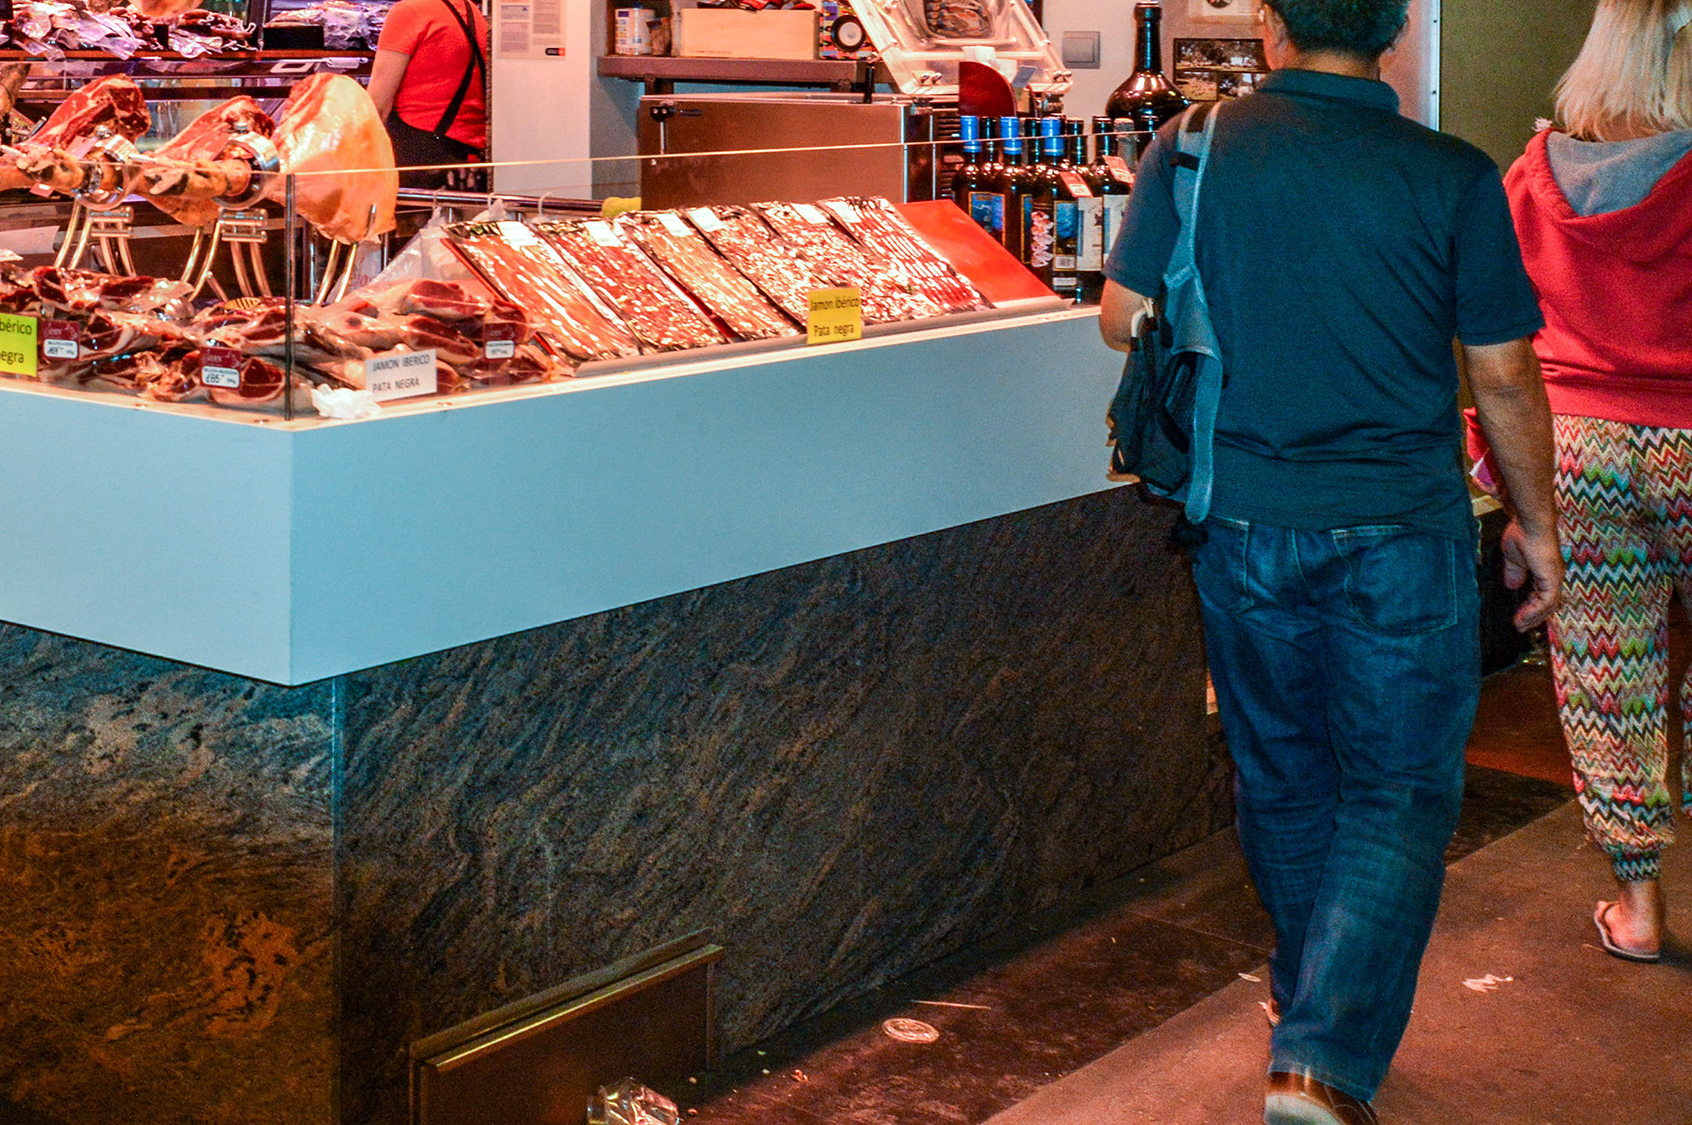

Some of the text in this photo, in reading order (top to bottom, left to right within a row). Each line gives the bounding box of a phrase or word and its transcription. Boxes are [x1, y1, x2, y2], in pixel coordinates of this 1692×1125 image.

[813, 323, 854, 337] Pata negra
[372, 358, 399, 372] JAMON
[372, 378, 421, 393] PATA NEGRA
